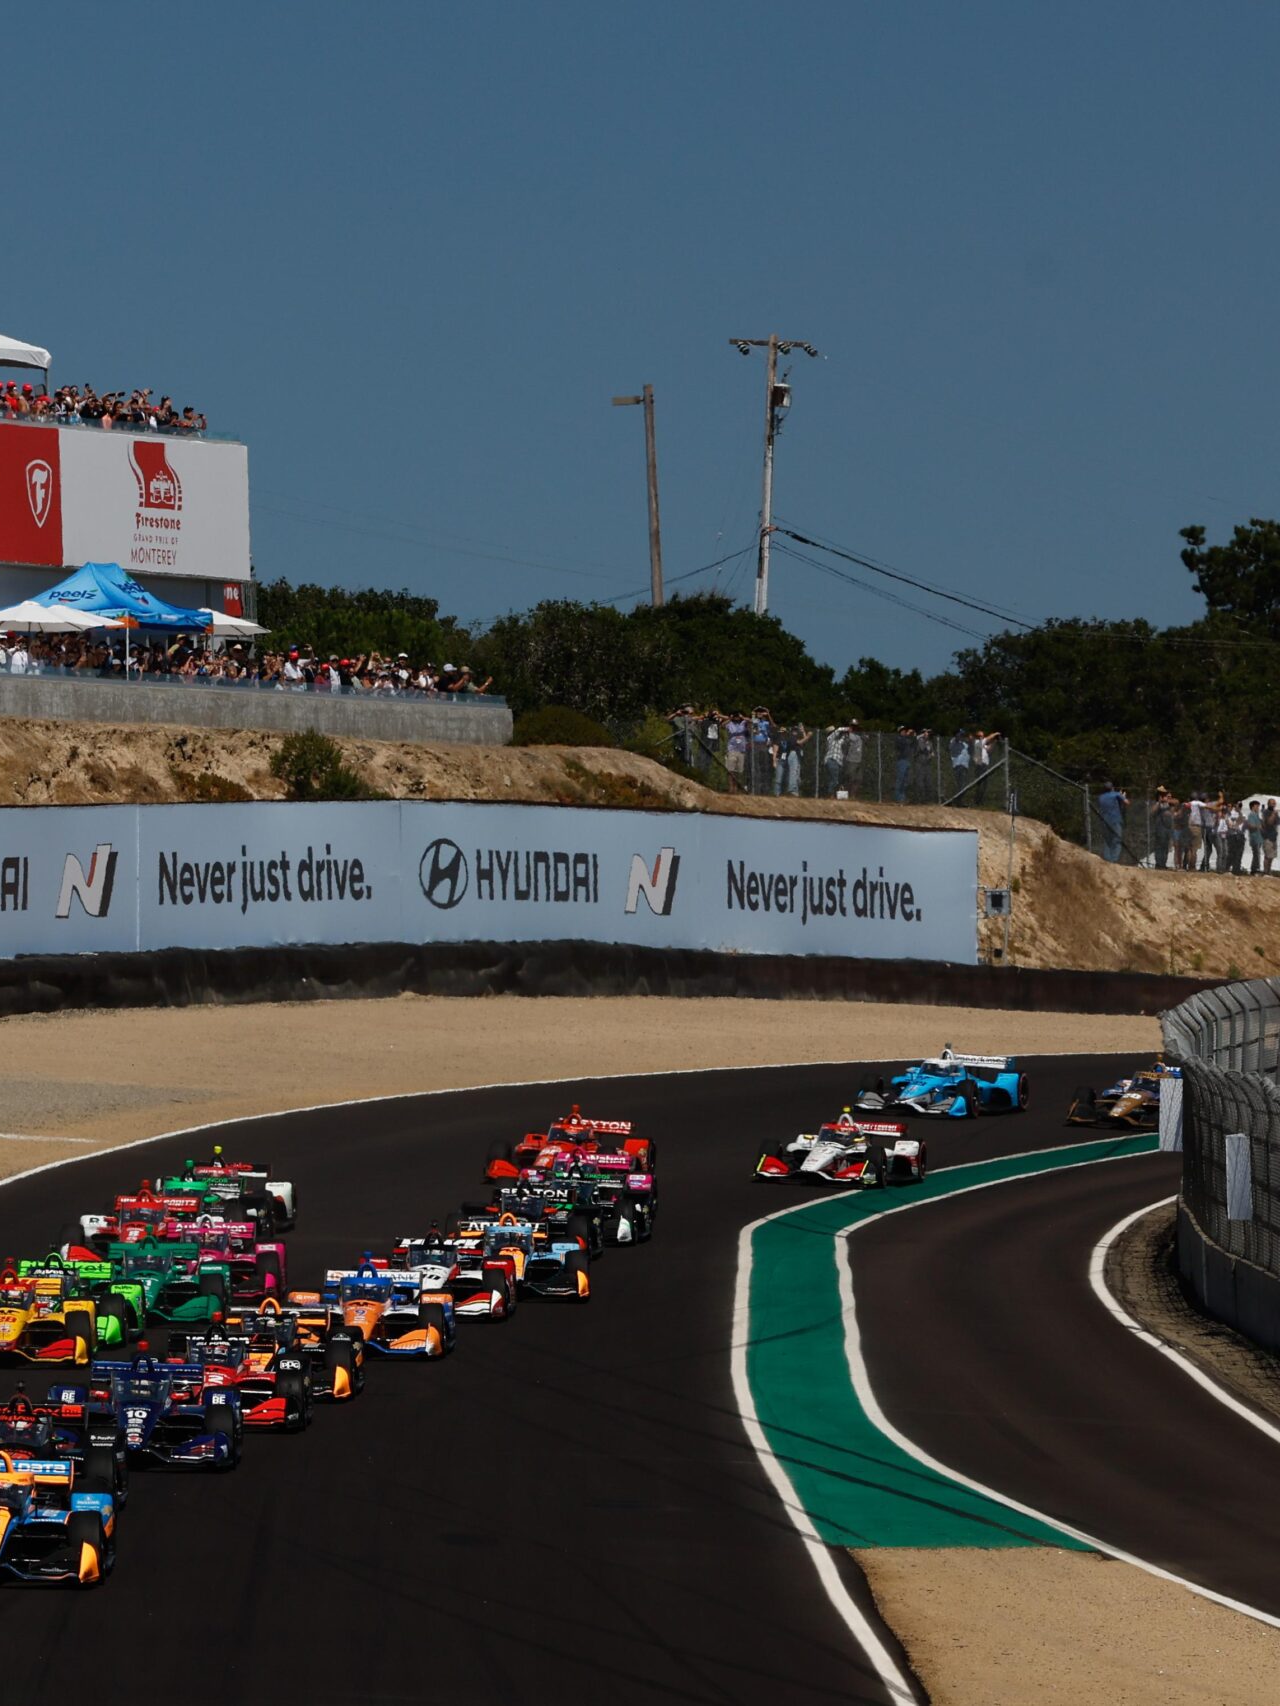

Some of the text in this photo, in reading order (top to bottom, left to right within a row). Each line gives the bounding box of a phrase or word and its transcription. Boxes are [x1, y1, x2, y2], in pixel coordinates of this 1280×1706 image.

[135, 512, 181, 530] Firestone
[130, 547, 177, 565] MONTEREY
[49, 589, 97, 600] peelz
[224, 586, 239, 600] ne
[158, 851, 236, 906] Never
[241, 845, 291, 915] just
[298, 844, 373, 901] drive.
[475, 849, 599, 903] HYUNDAI
[727, 859, 799, 913] Never
[801, 861, 847, 926] just
[852, 866, 922, 922] drive.
[126, 1410, 148, 1419] 10
